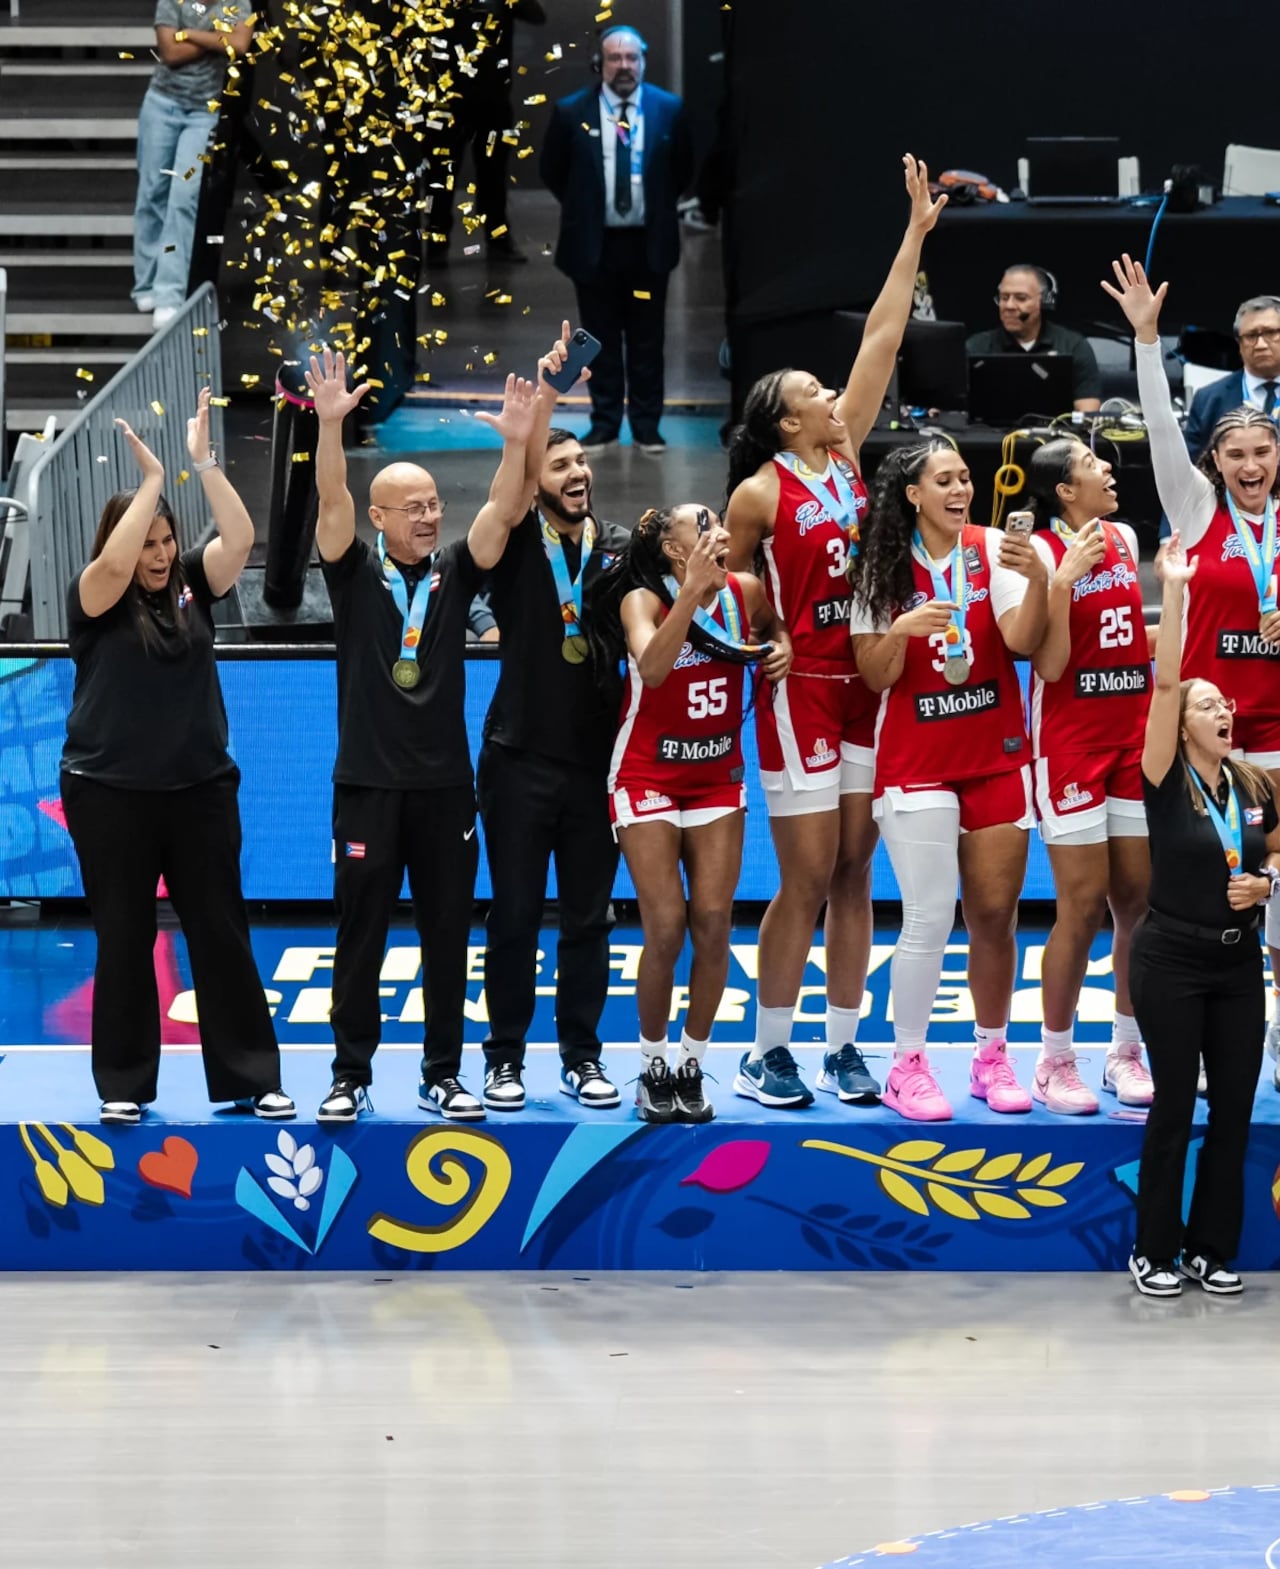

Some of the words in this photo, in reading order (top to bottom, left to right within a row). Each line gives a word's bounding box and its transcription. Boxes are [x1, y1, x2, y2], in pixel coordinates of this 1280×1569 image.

[1099, 605, 1134, 649] 25
[1099, 670, 1146, 692] Mobile
[687, 676, 728, 719] 55
[937, 687, 995, 715] Mobile
[681, 736, 732, 760] Mobile
